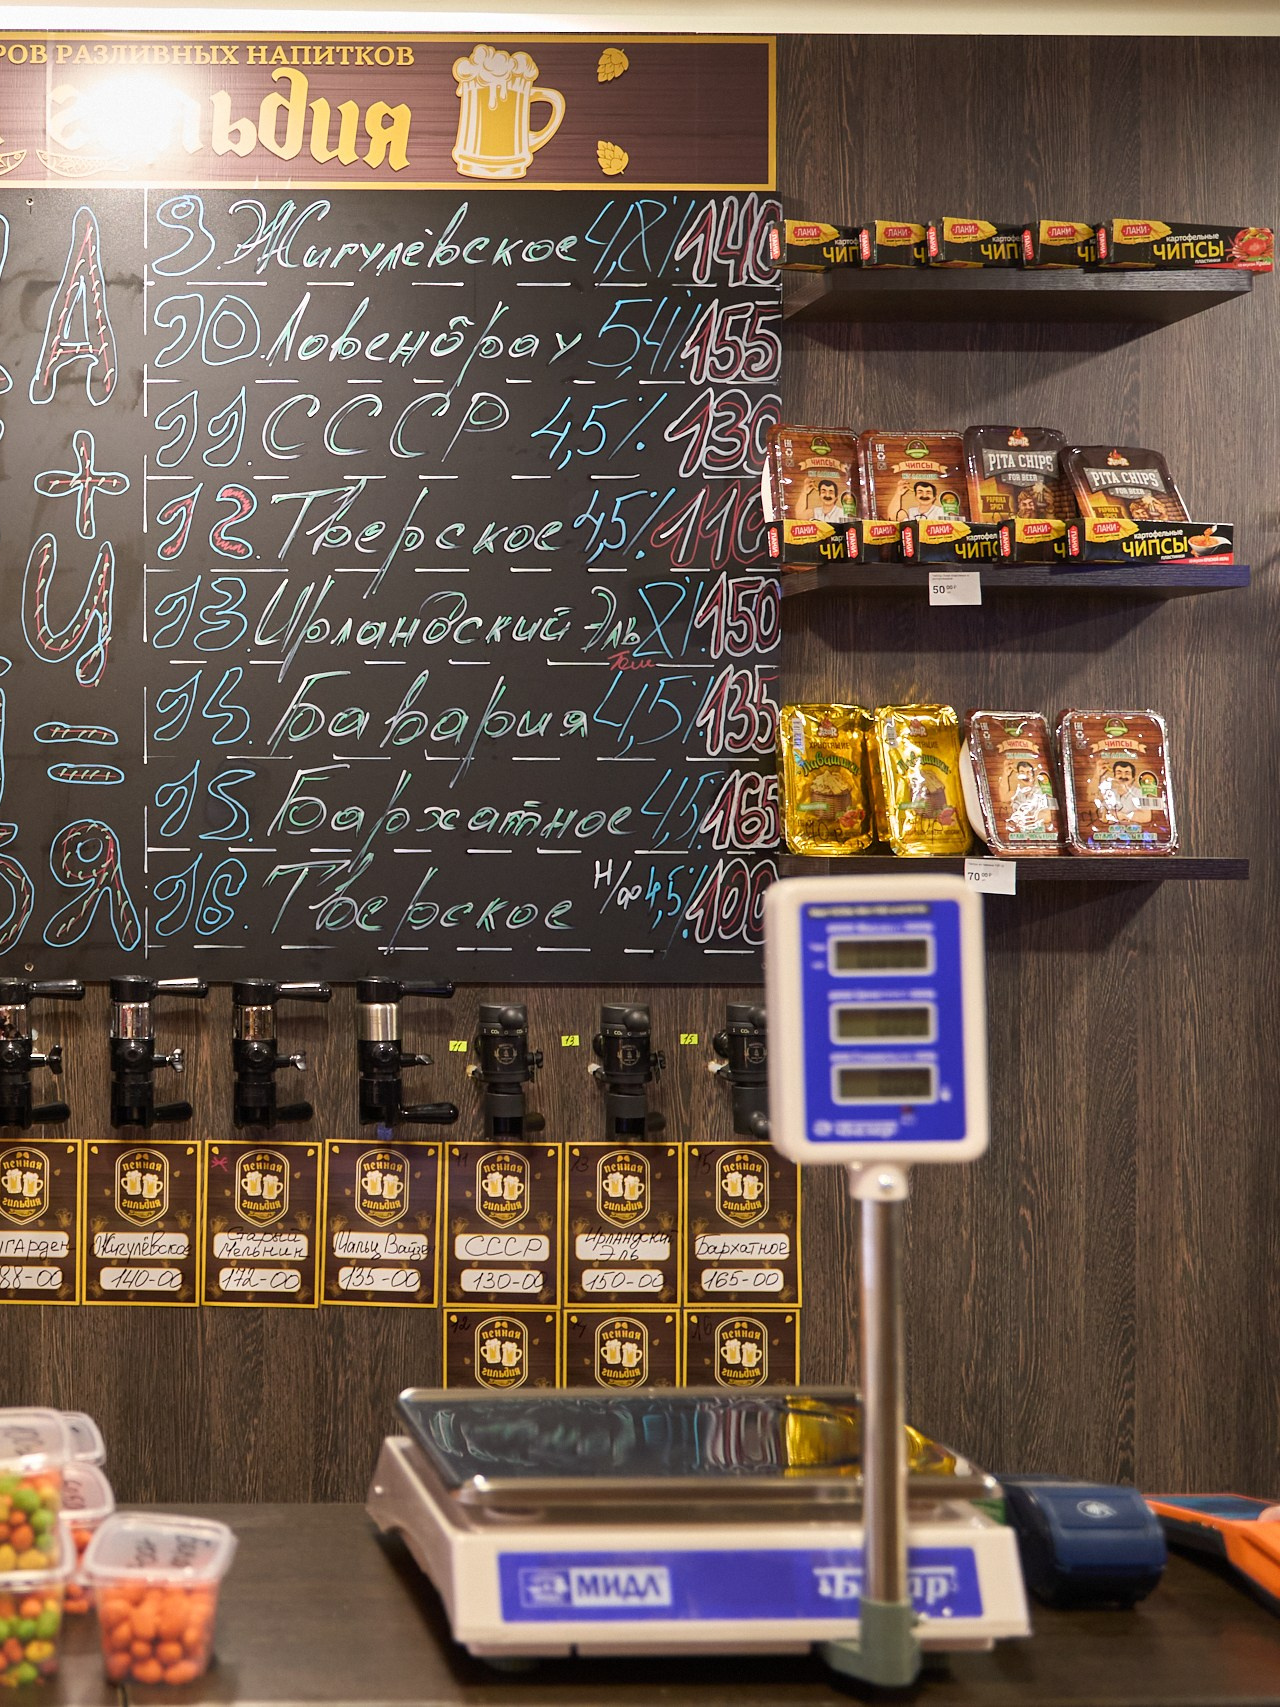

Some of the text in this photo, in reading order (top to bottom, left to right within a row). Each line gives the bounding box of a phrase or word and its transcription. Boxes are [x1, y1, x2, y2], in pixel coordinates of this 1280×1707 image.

[55, 45, 240, 65] РАЗЛИВНЫХ
[246, 45, 415, 65] НАПИТКОВ
[1126, 227, 1148, 235] ЛАКИ
[1153, 241, 1224, 260] ЧИПСЫ
[681, 299, 782, 385] 155
[262, 392, 509, 462] СССР
[989, 454, 1054, 472] PITA CHIPS
[1122, 537, 1188, 557] ЧИПСЫ
[693, 571, 781, 659] 150
[696, 664, 779, 756] 135
[699, 769, 780, 850] 165
[465, 1236, 542, 1257] СССР
